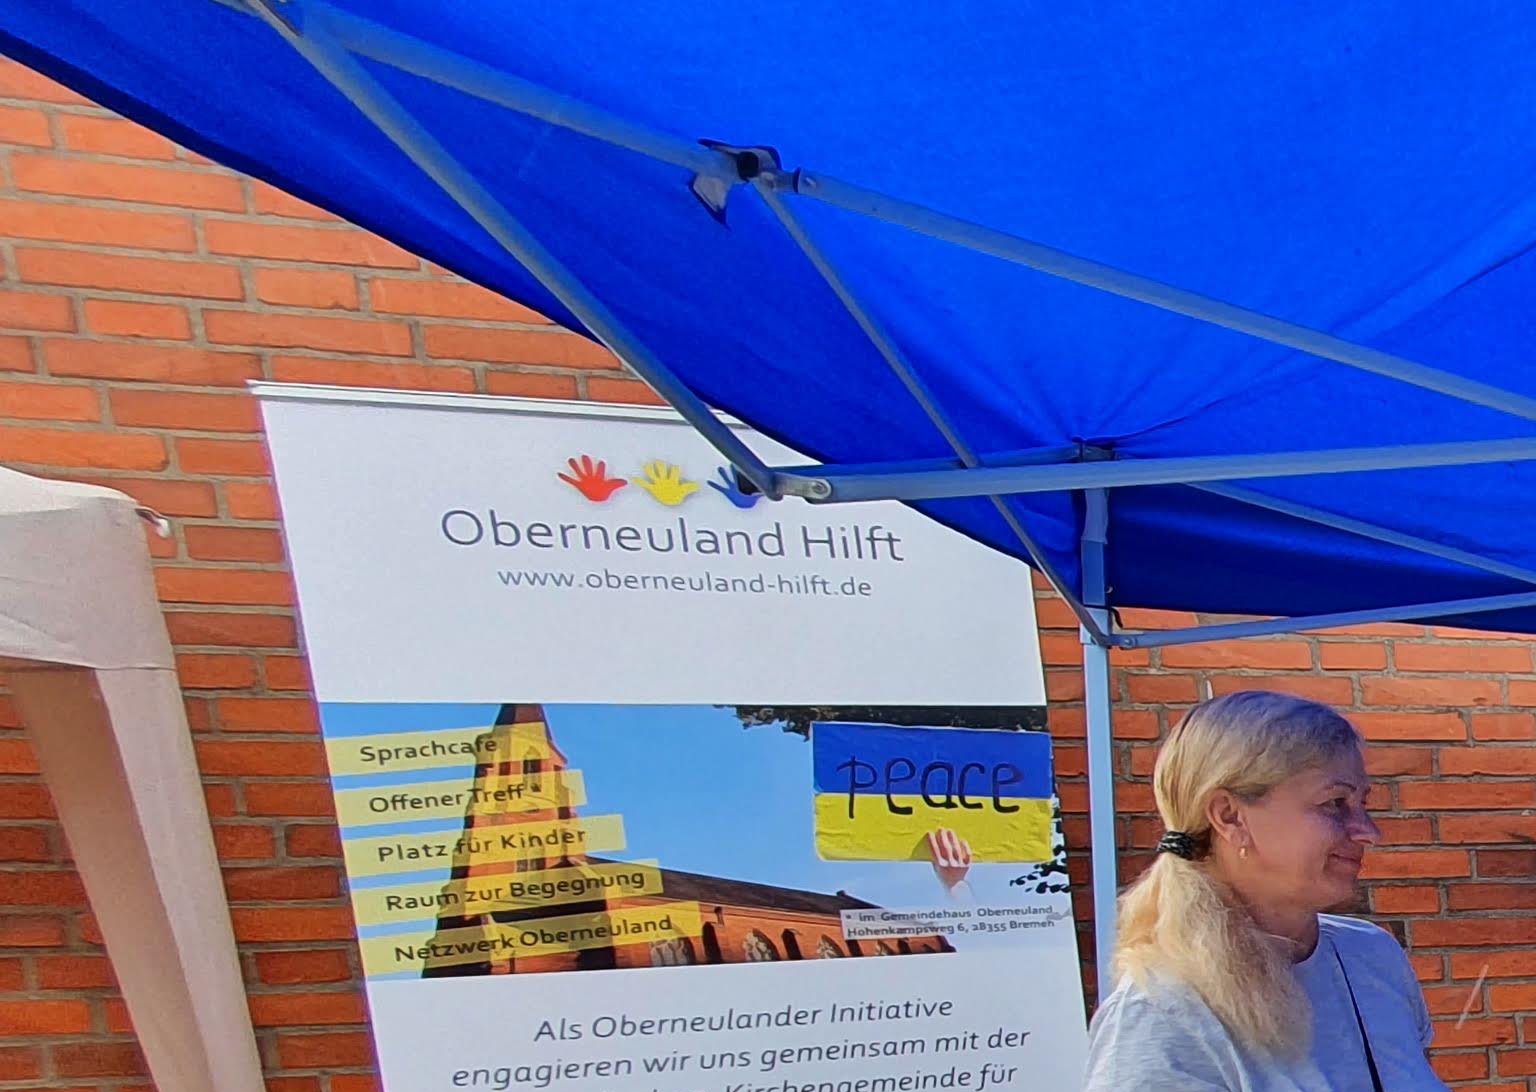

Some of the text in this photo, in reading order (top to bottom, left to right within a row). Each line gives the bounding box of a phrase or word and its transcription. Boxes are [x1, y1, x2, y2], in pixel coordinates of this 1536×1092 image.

[441, 509, 905, 562] Oberneuland Hilft
[497, 570, 873, 597] www.oberneuland-hilft.de
[369, 782, 526, 813] Offener Treff
[836, 755, 1024, 819] peace
[377, 828, 587, 862] Platz für Kinder
[386, 871, 645, 911] Raum zur Begegnung
[859, 905, 1054, 922] im Gemeindehaus Oberneuland
[1010, 919, 1055, 930] Bremen
[394, 915, 673, 962] Netzwerk Oberneuland
[533, 998, 953, 1042] Als Oberneulander Initiative
[452, 1027, 1031, 1091] engagieren wir uns gemeinsam mit der
[975, 1063, 1018, 1091] für
